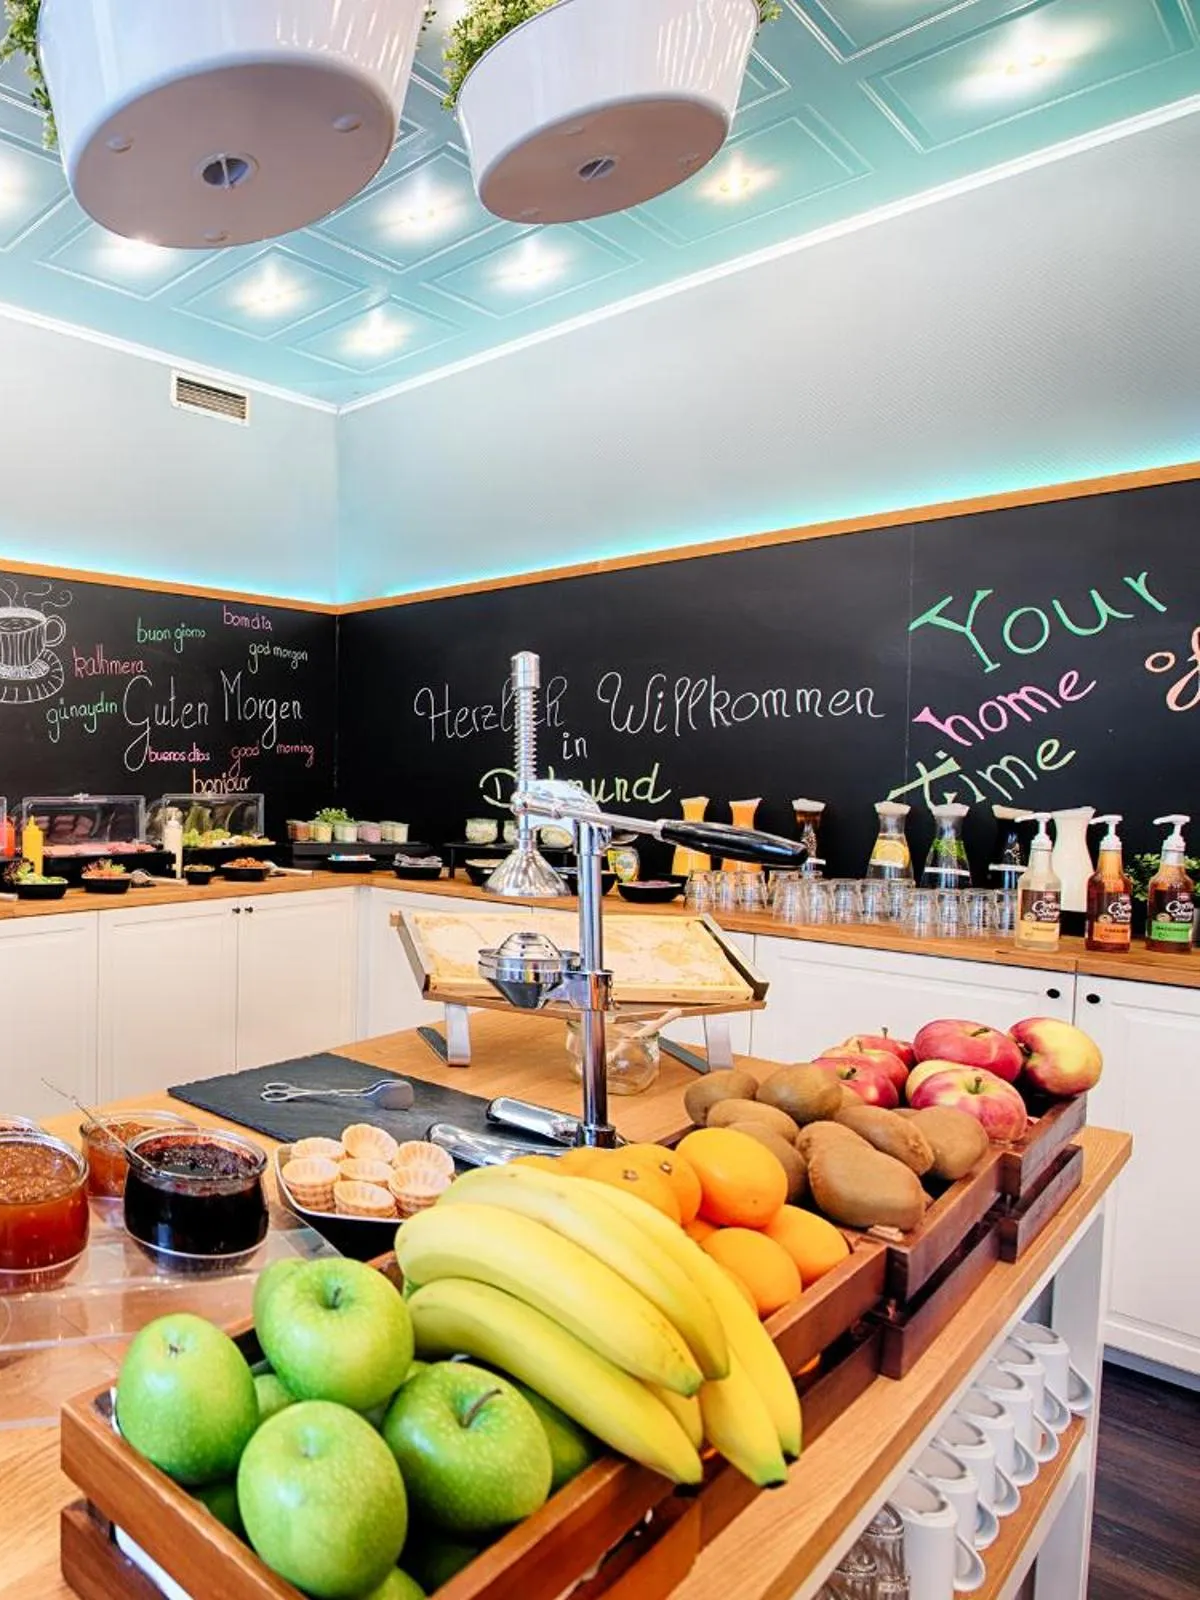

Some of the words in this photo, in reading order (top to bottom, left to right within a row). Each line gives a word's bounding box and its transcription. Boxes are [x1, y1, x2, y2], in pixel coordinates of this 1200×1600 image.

[137, 617, 171, 643] buon
[907, 571, 1167, 673] Your
[123, 674, 209, 772] Guten
[220, 669, 303, 750] Morgen
[414, 676, 567, 742] Herzlh
[596, 671, 885, 737] Willkommen
[912, 669, 1096, 747] home
[562, 732, 588, 760] in
[886, 738, 1076, 812] time
